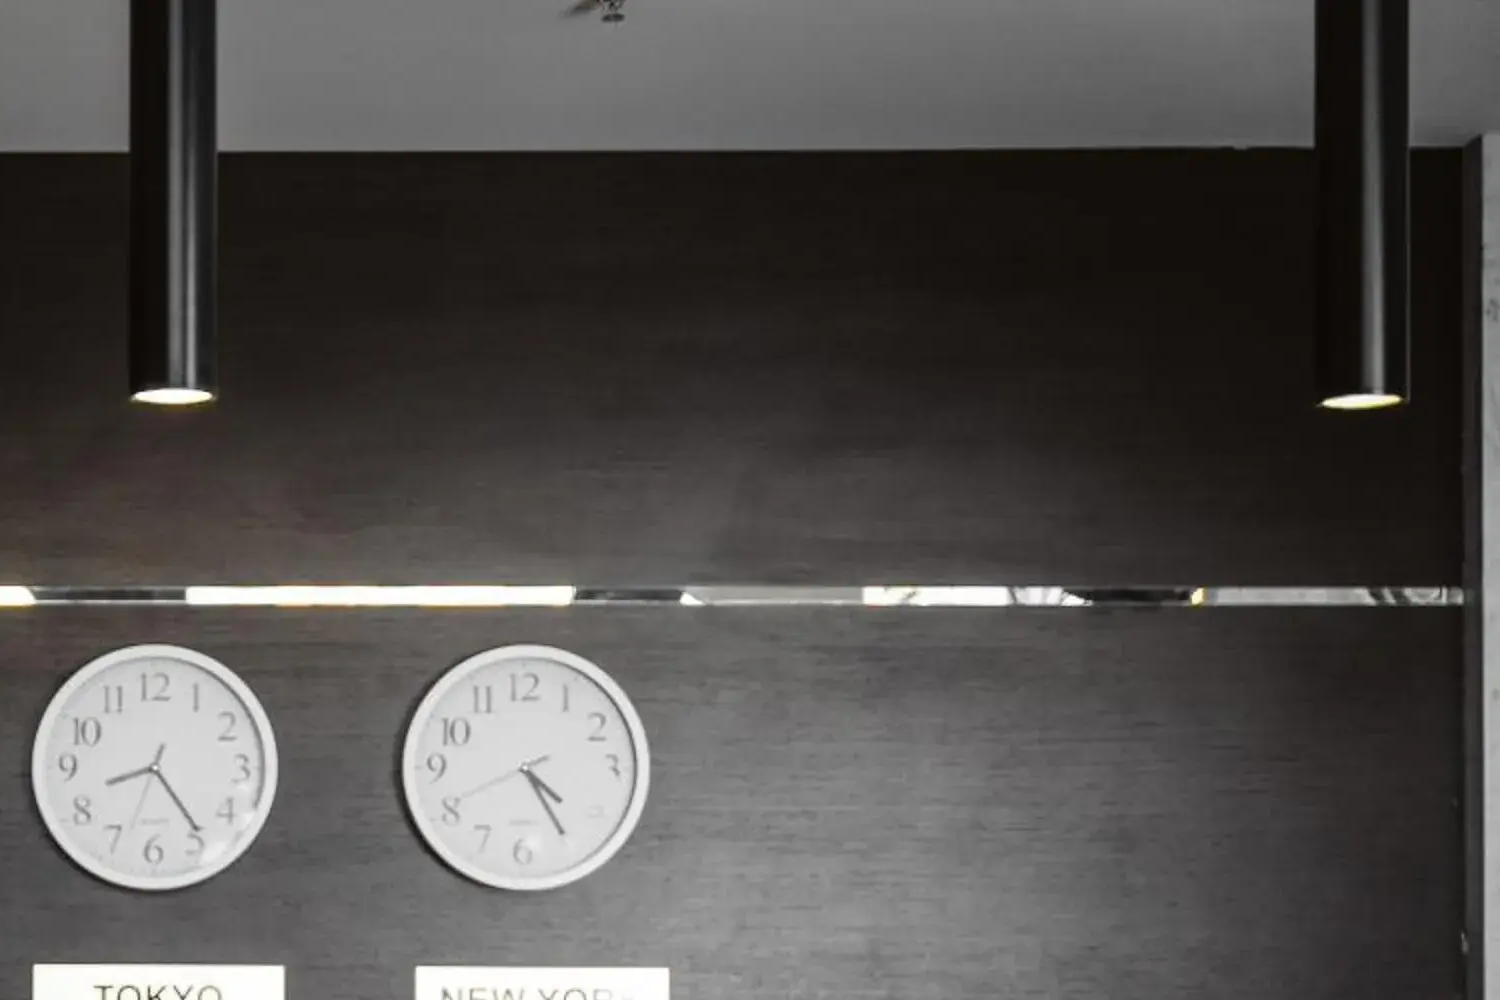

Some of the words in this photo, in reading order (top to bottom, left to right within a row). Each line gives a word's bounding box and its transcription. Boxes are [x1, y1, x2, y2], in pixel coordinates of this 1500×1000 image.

[103, 685, 123, 714] 11
[140, 672, 171, 701] 12
[191, 683, 200, 712] 1
[473, 686, 492, 714] 11
[509, 673, 540, 702] 12
[561, 684, 569, 712] 1
[73, 717, 102, 746] 10
[218, 712, 237, 741] 2
[442, 717, 471, 746] 10
[588, 713, 607, 741] 2
[59, 753, 77, 782] 9
[232, 754, 250, 783] 3
[427, 753, 446, 784] 9
[73, 795, 91, 825] 8
[215, 797, 235, 825] 4
[442, 797, 460, 825] 8
[104, 825, 122, 853] 7
[143, 834, 163, 864] 6
[186, 826, 204, 855] 5
[473, 825, 491, 853] 7
[513, 838, 532, 864] 6
